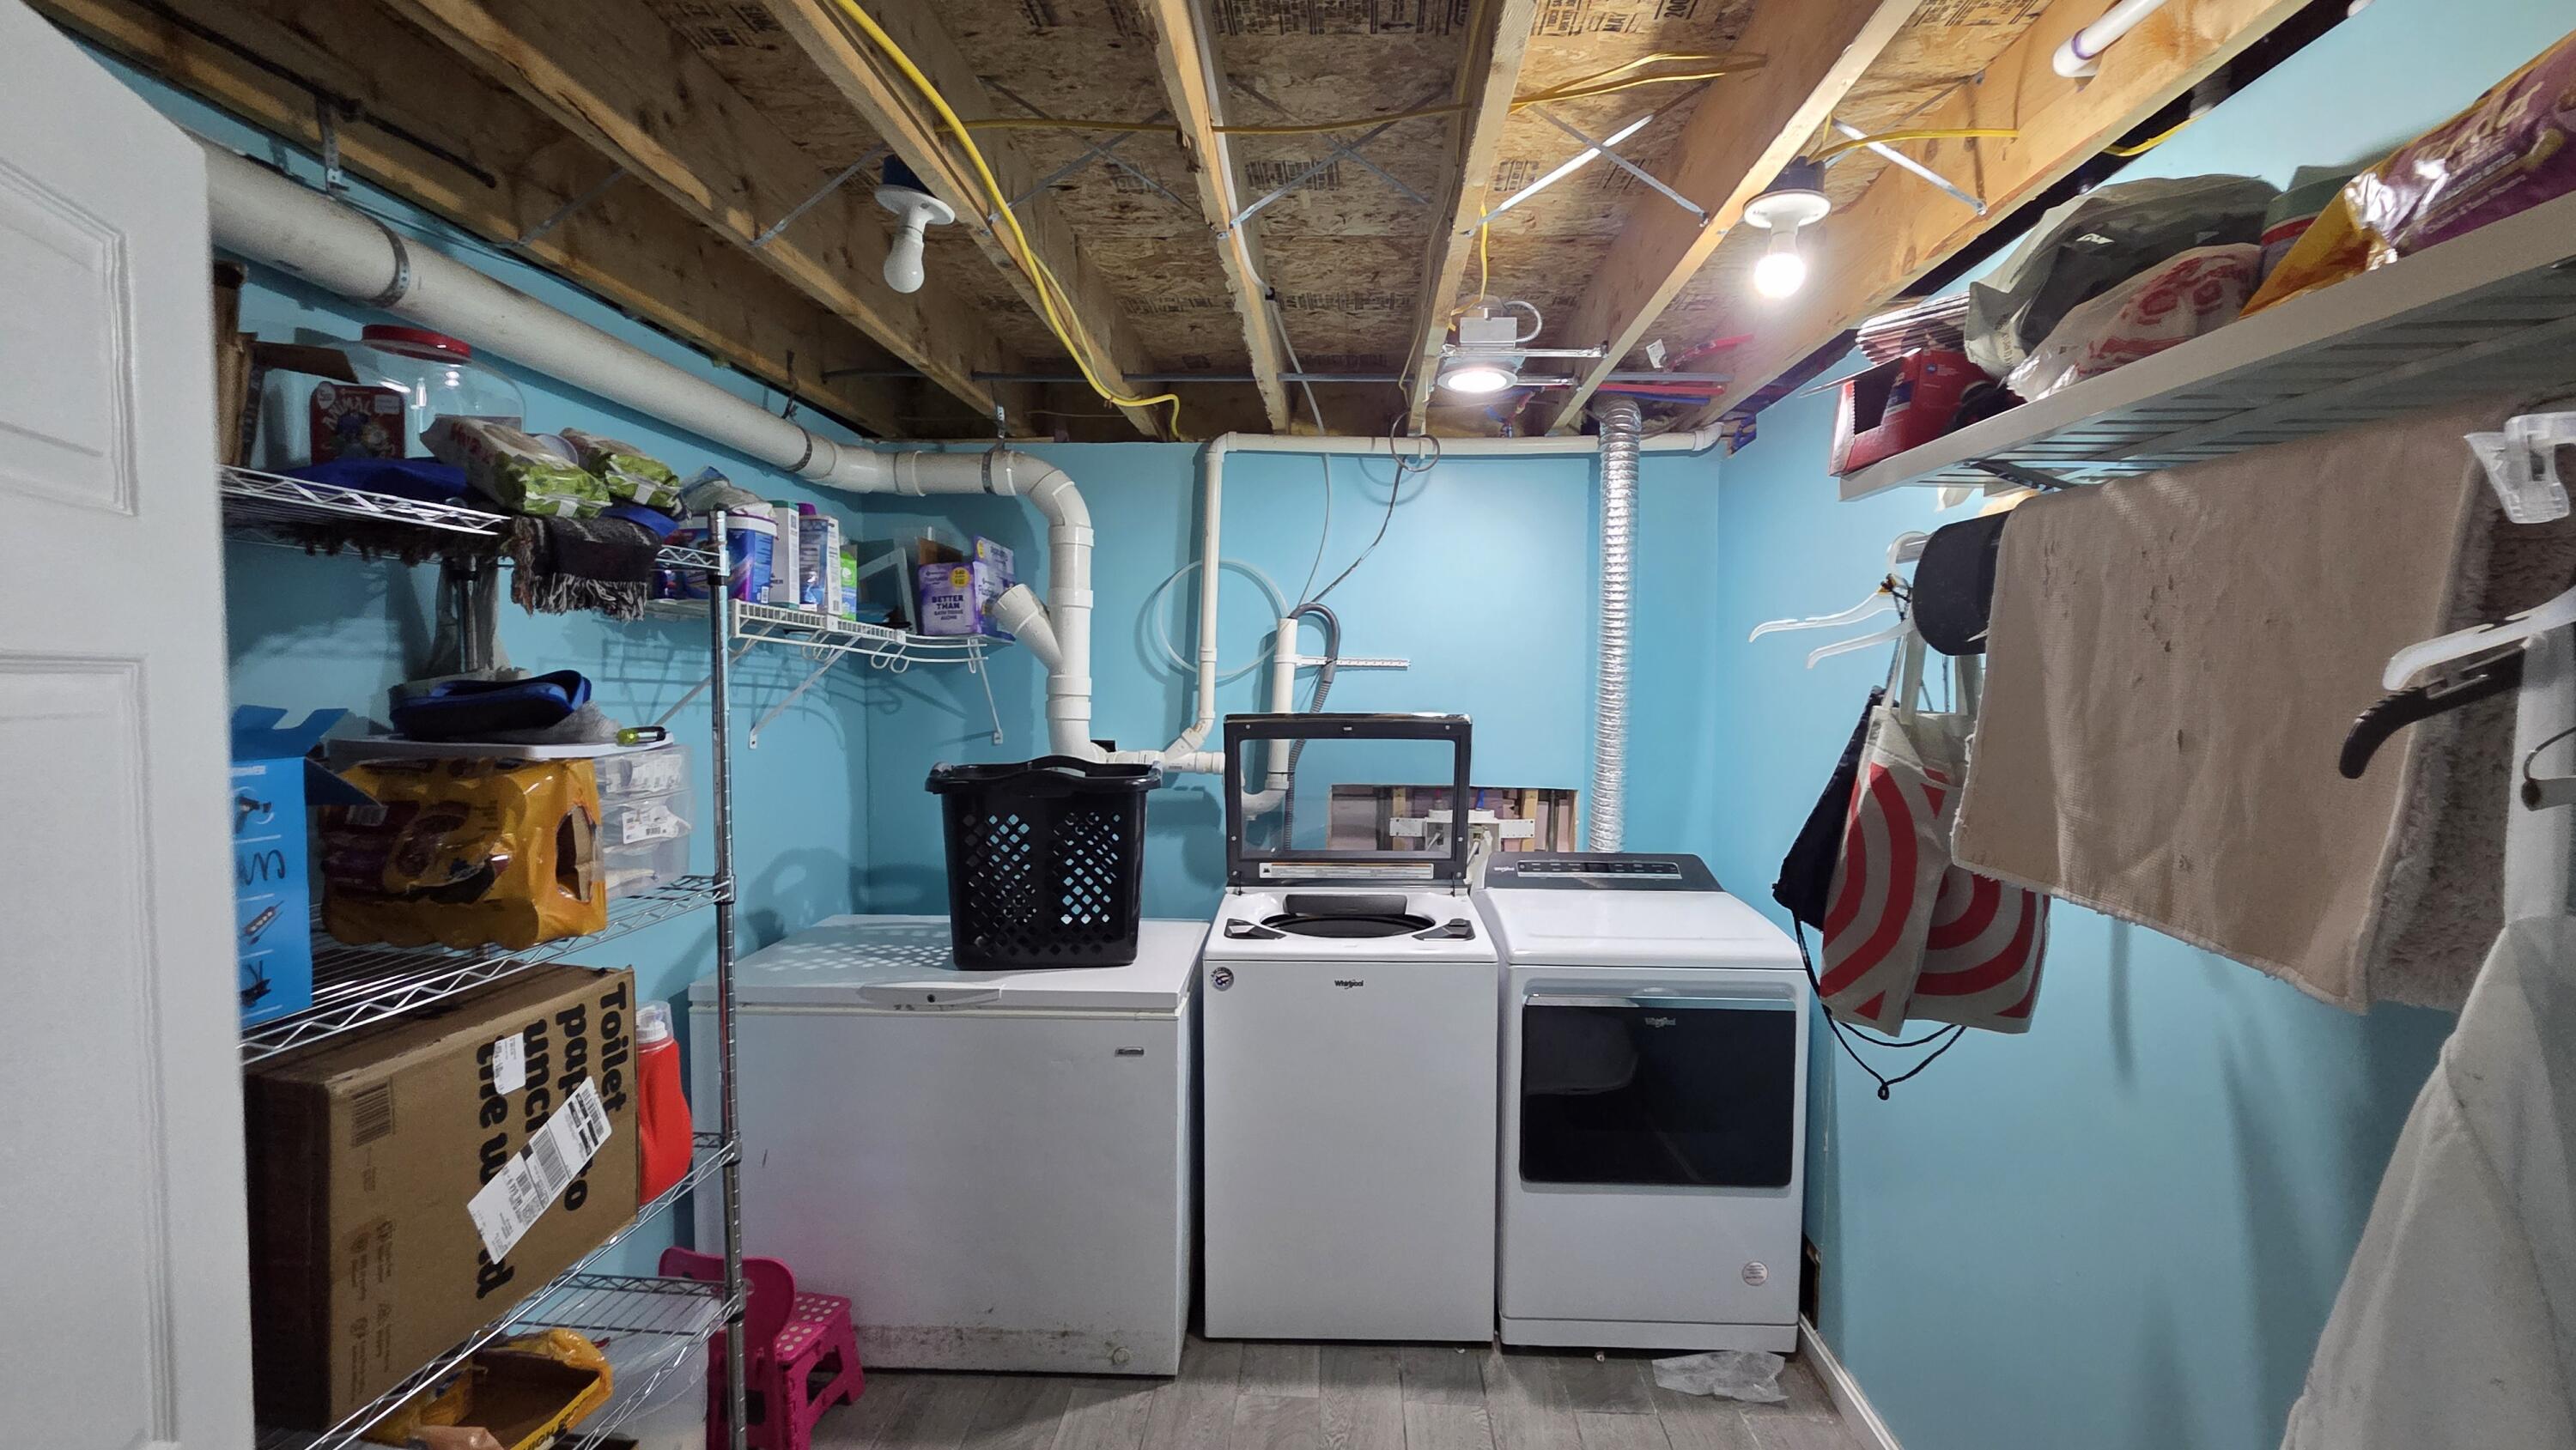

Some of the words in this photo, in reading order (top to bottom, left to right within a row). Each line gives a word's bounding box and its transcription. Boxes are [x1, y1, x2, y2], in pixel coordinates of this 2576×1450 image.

[932, 594, 963, 603] BETTER
[1334, 979, 1364, 989] Whirlpool
[556, 1003, 587, 1101] pap
[600, 981, 629, 1117] Toilet
